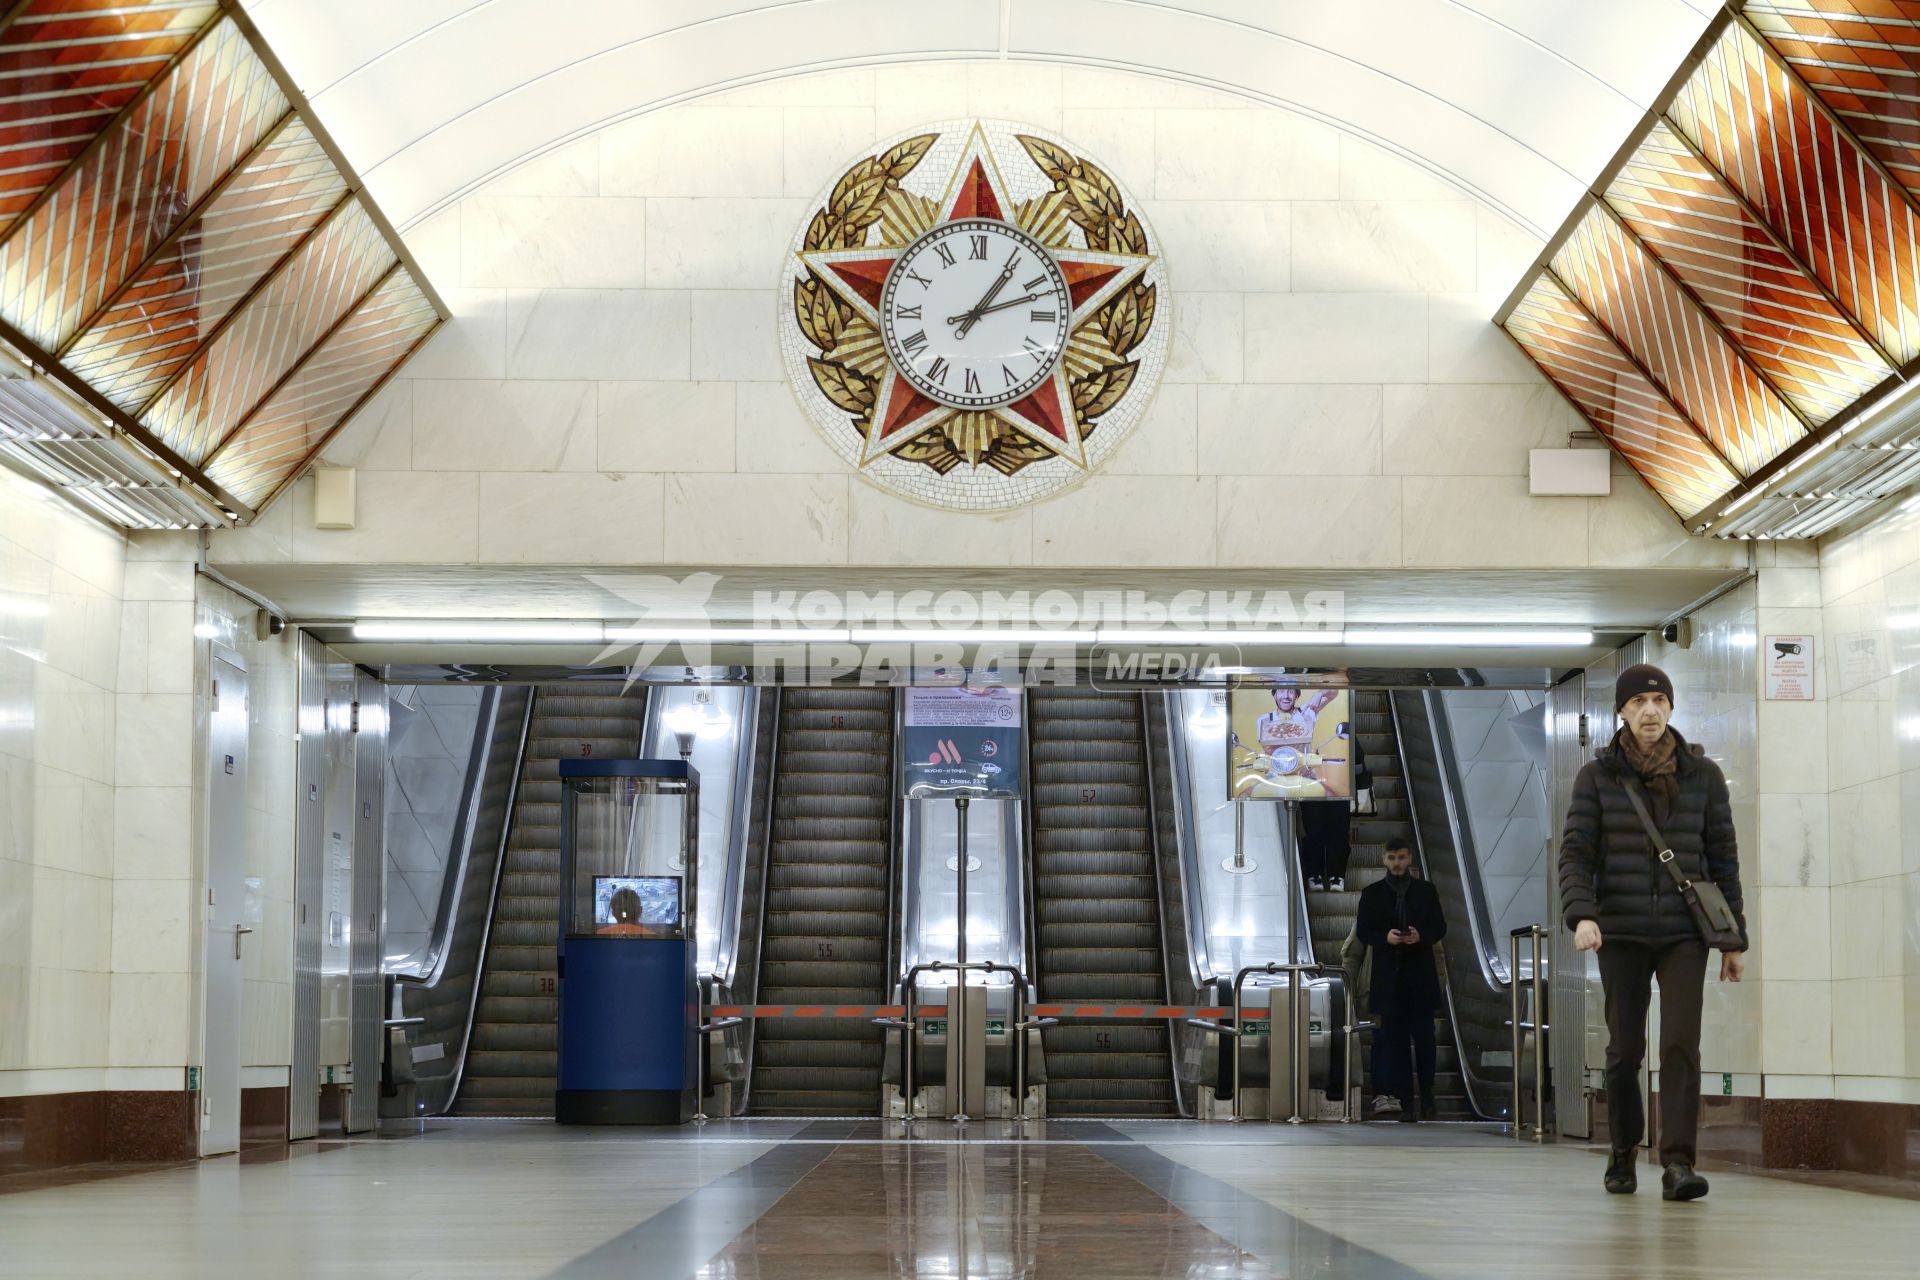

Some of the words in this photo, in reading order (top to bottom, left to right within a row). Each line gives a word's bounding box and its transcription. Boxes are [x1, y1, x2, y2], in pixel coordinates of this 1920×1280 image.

[932, 241, 957, 270] XI
[968, 235, 988, 260] XII
[1003, 246, 1021, 269] I
[906, 267, 933, 291] X
[1022, 273, 1049, 292] II
[896, 303, 922, 320] IX
[1030, 309, 1056, 323] III
[901, 328, 930, 362] VIII
[925, 355, 950, 386] VII
[1001, 362, 1020, 387] V
[964, 368, 983, 394] VI
[831, 715, 844, 729] 56
[581, 744, 592, 758] 39
[1082, 789, 1096, 803] 57
[818, 943, 833, 958] 55
[540, 977, 555, 993] 38
[1096, 1032, 1111, 1049] 56
